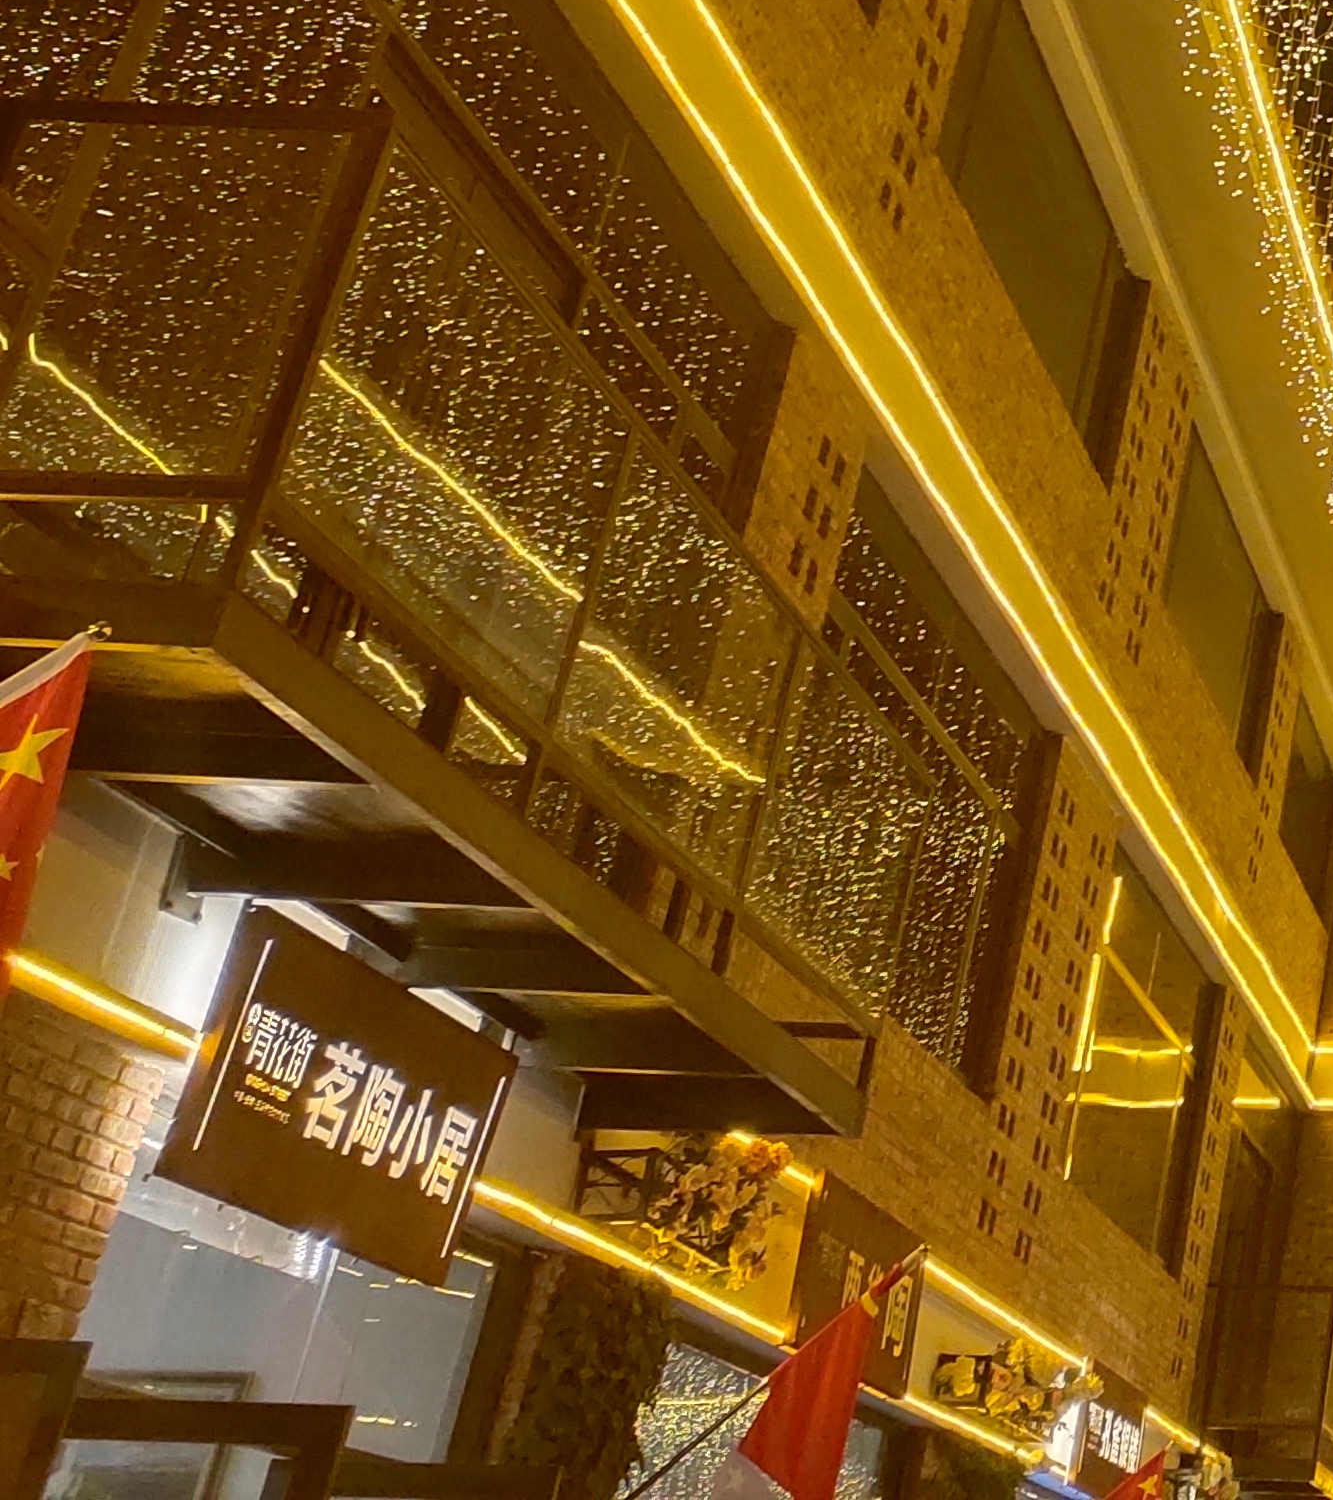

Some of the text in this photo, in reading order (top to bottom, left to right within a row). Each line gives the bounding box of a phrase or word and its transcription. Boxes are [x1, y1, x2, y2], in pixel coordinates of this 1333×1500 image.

[245, 1008, 318, 1089] 青花街
[303, 1041, 478, 1204] 茗陶小居
